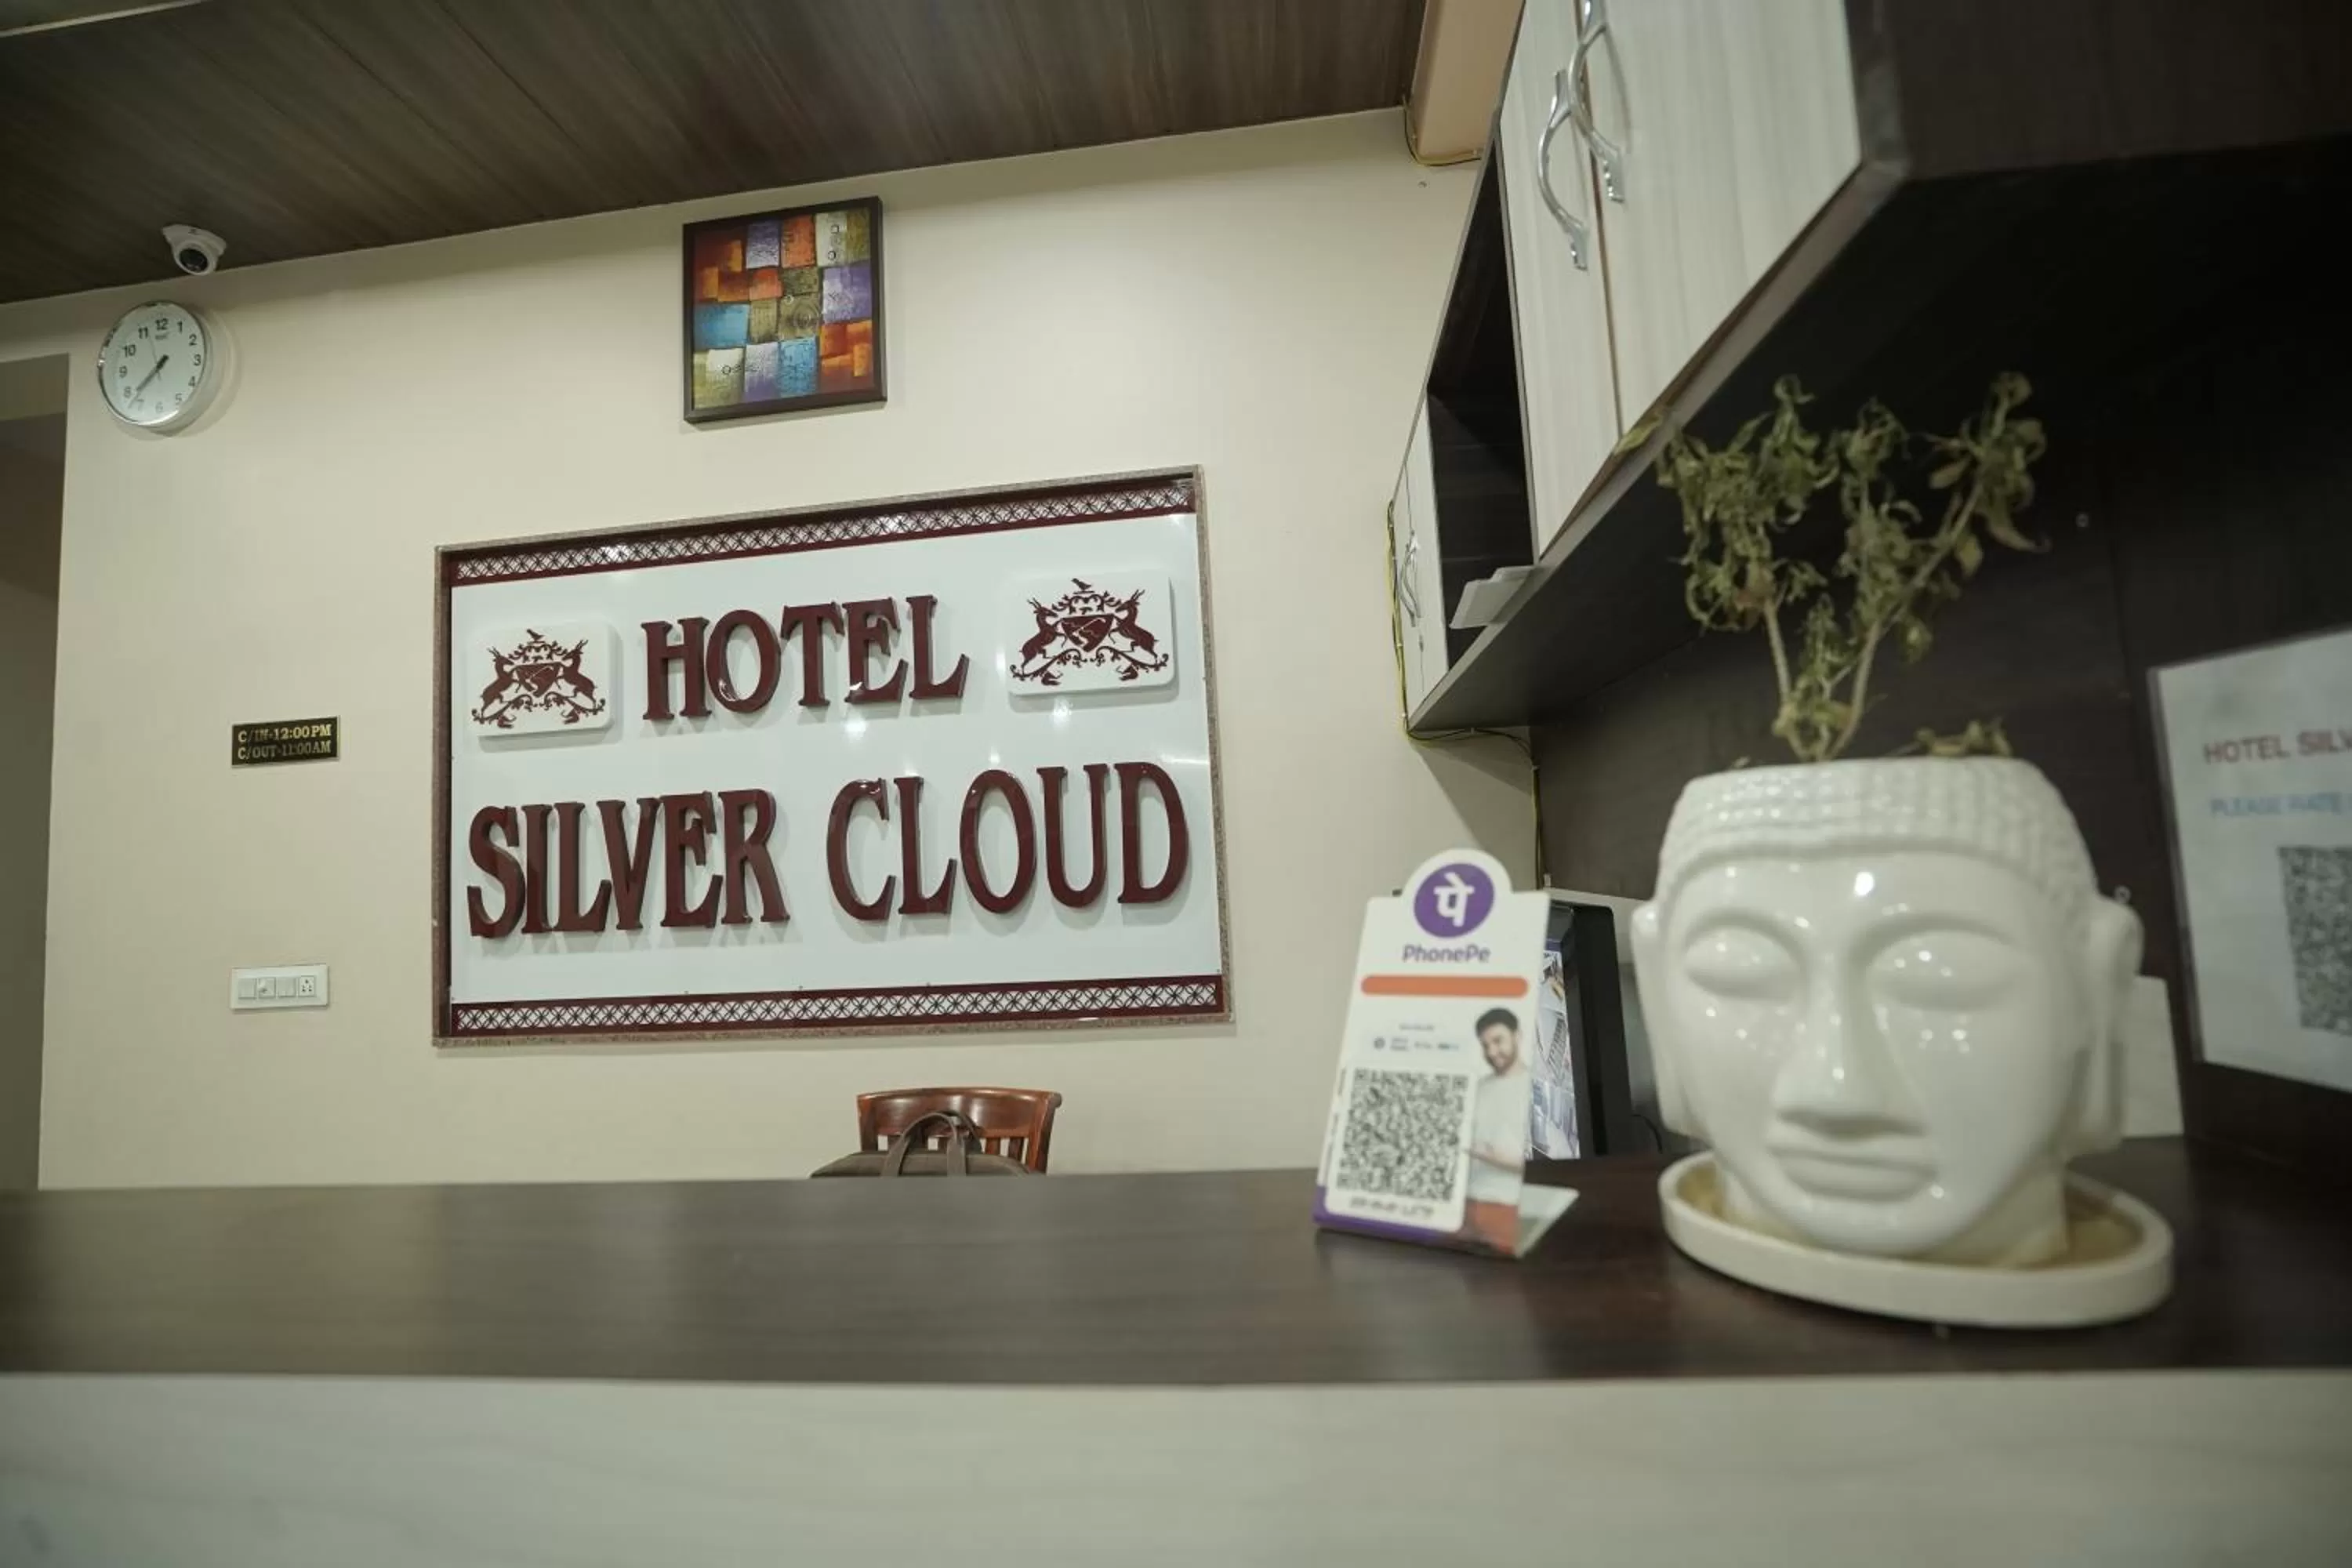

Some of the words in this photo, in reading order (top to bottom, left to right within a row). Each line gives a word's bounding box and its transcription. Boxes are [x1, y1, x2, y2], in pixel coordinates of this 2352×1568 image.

[155, 318, 169, 331] 12
[177, 321, 183, 333] 1
[138, 327, 148, 339] 11
[188, 334, 197, 346] 2
[123, 344, 136, 358] 10
[194, 354, 201, 366] 3
[119, 365, 128, 378] 9
[188, 376, 195, 387] 4
[175, 394, 183, 405] 5
[641, 593, 970, 721] HOTEL
[2203, 735, 2291, 765] HOTEL
[466, 787, 790, 938] SILVER
[826, 760, 1190, 922] CLOUD
[1433, 872, 1475, 927] पे
[1402, 943, 1491, 964] PhonePe
